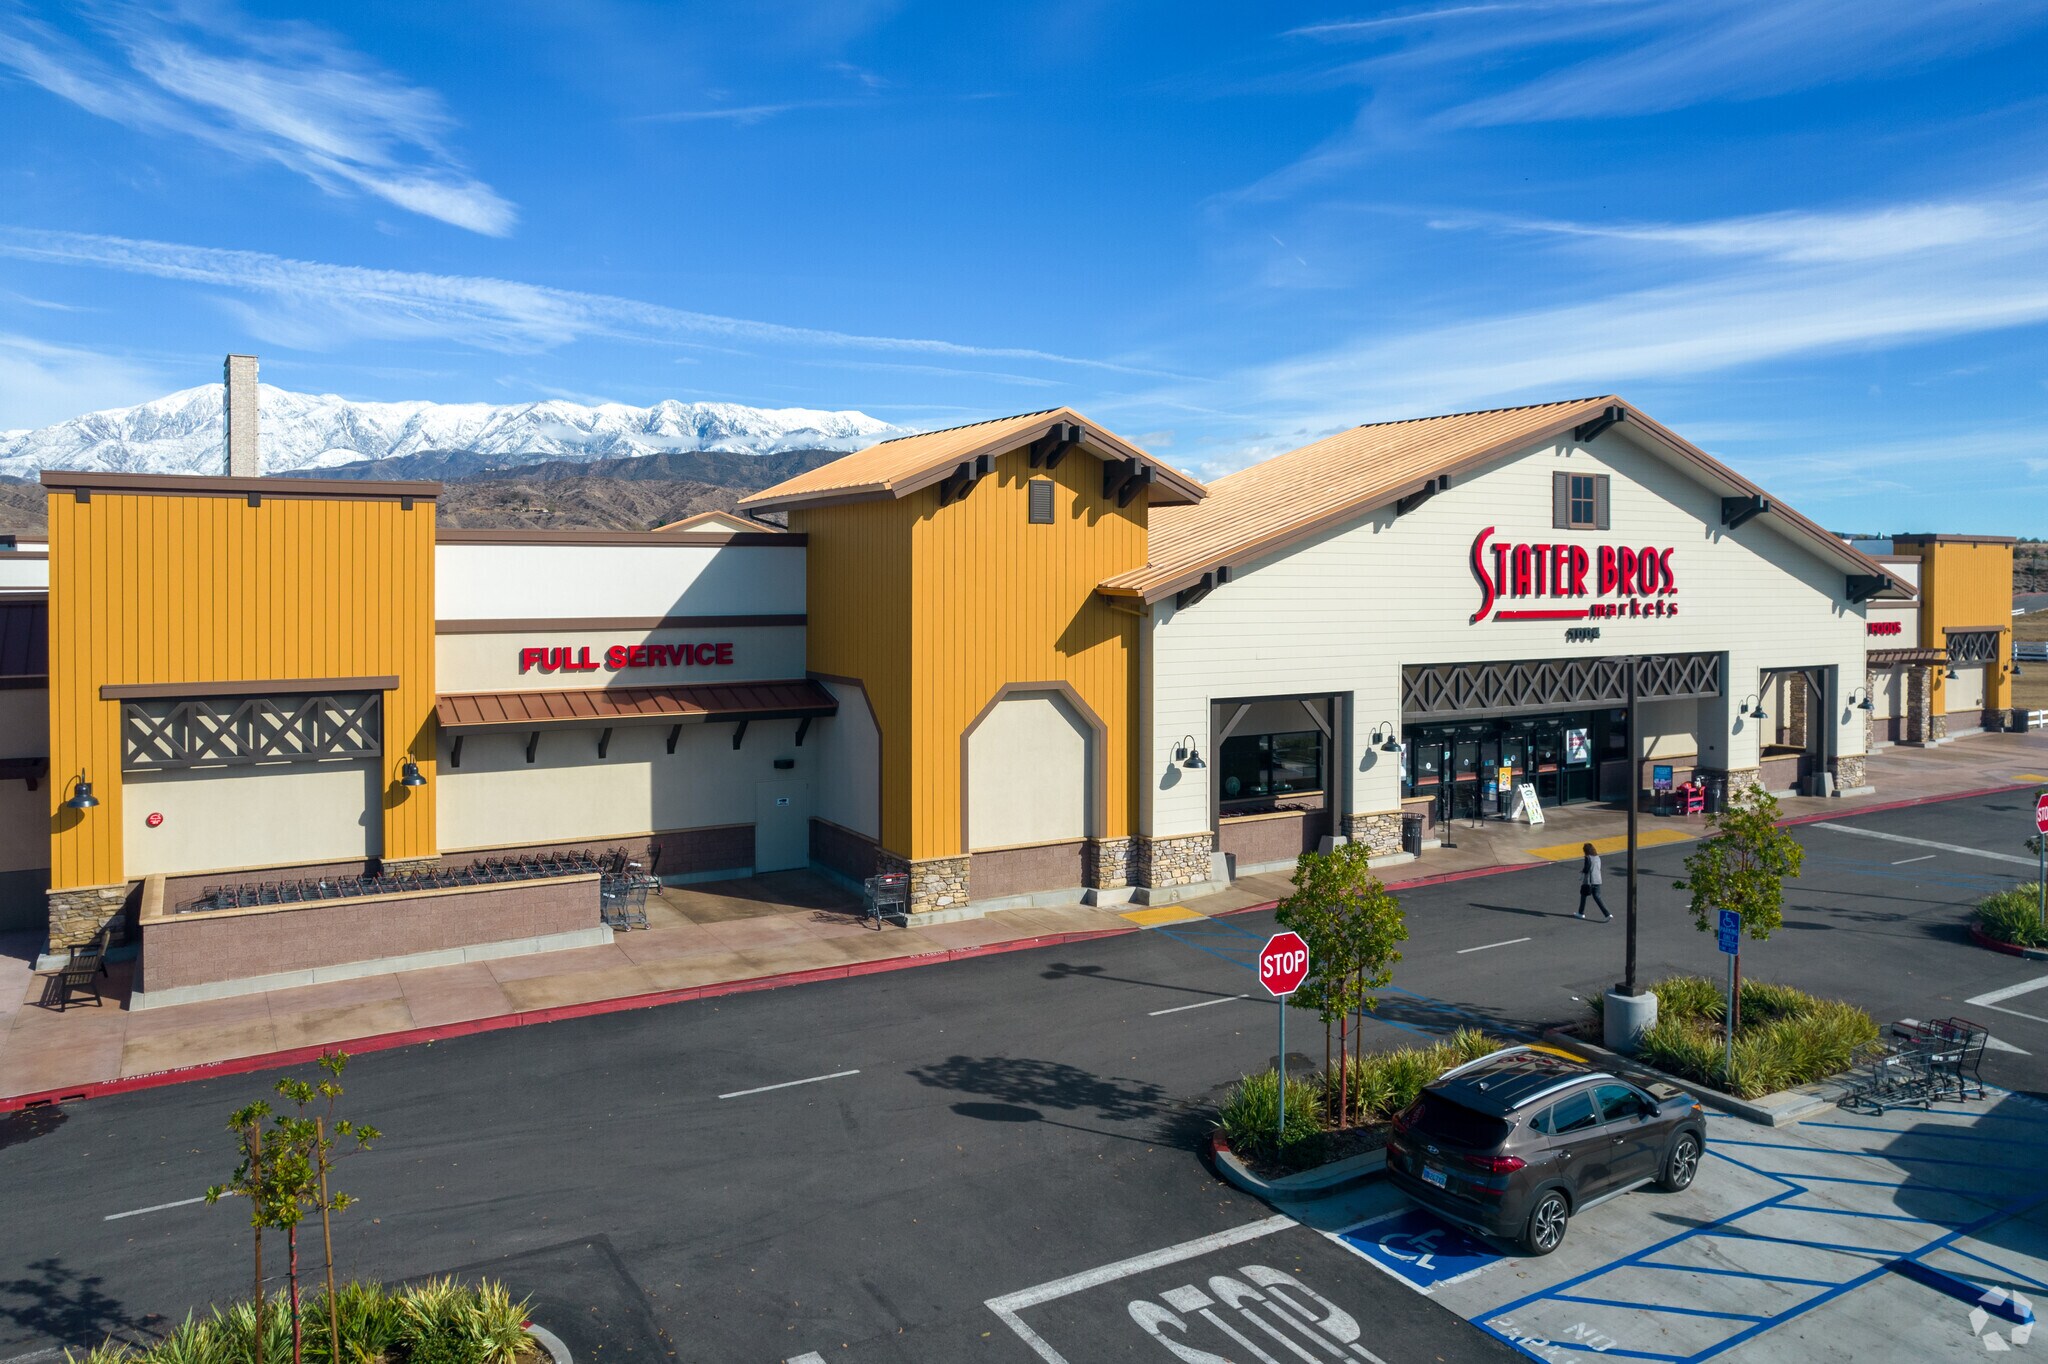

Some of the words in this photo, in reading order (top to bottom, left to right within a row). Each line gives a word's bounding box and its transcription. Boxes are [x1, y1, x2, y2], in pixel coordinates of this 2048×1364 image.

[1470, 526, 1589, 624] STATER
[1590, 598, 1678, 618] markets
[521, 646, 600, 673] FULL
[607, 643, 733, 669] SERVICE
[2038, 806, 2048, 822] STO
[1263, 950, 1305, 978] STOP
